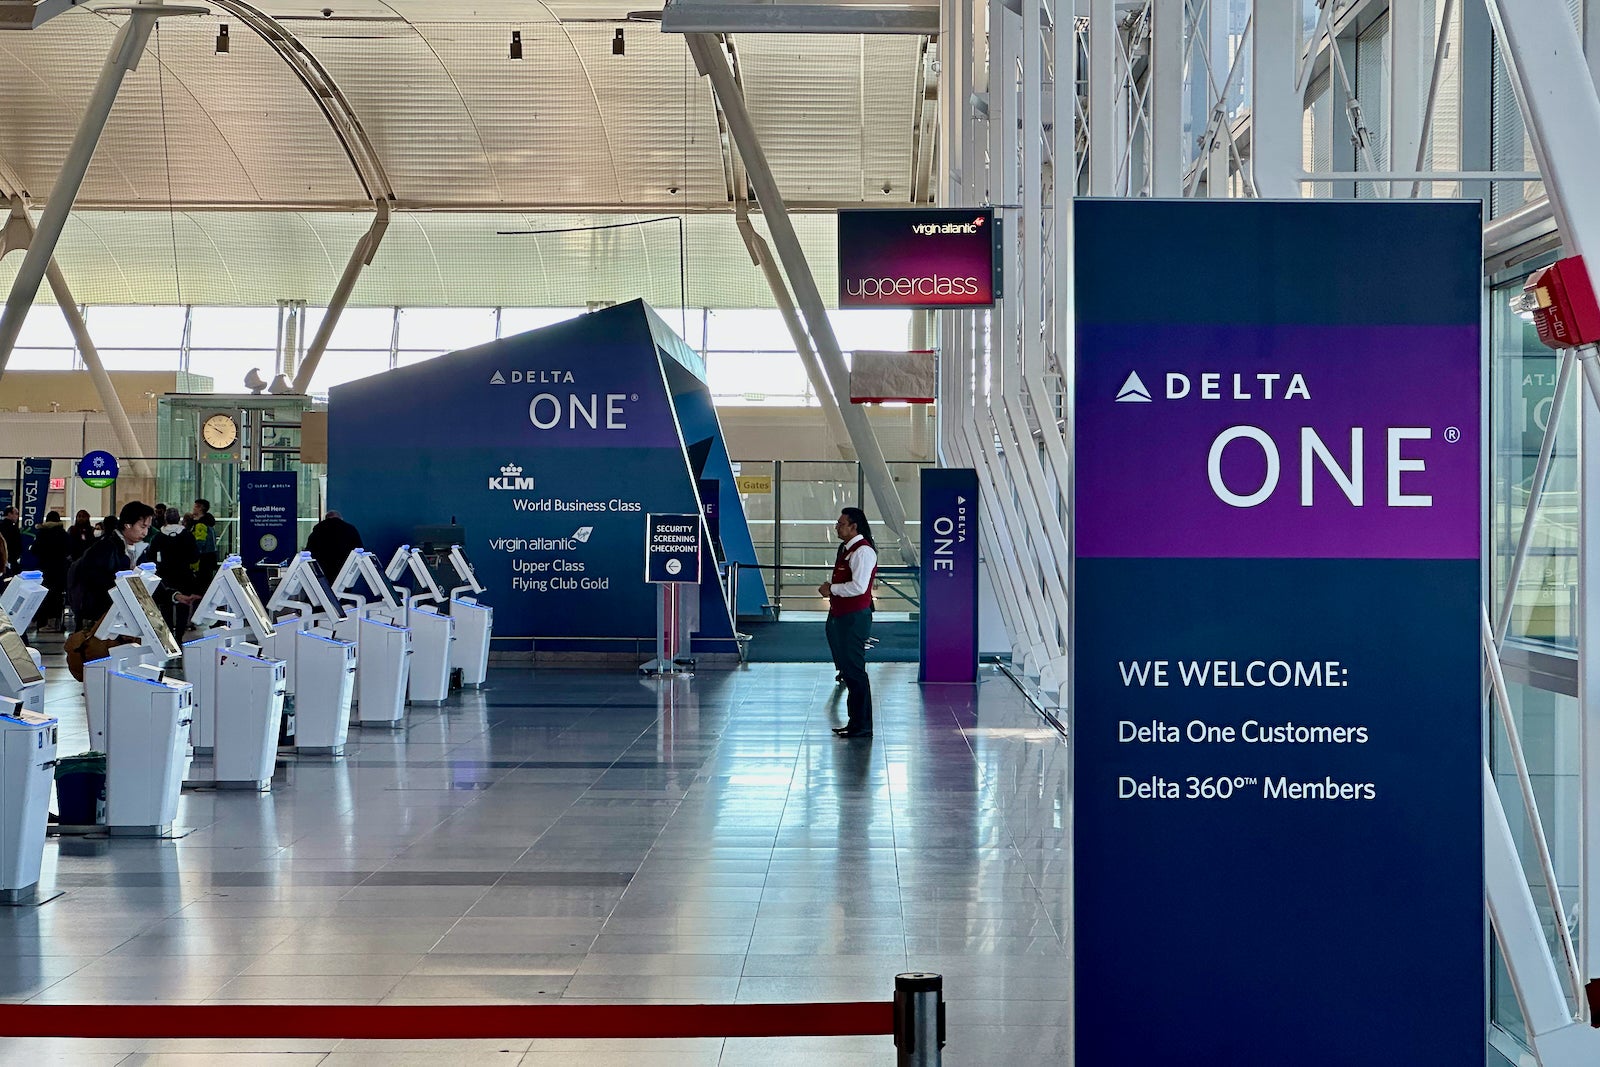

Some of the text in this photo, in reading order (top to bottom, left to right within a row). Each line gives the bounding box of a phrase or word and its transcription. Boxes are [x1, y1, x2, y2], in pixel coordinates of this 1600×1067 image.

[846, 274, 978, 300] upperclass
[1549, 306, 1566, 338] FIRE
[511, 371, 575, 383] DELTA
[1166, 373, 1311, 400] DELTA
[488, 477, 534, 490] KLM
[743, 481, 769, 489] Gates
[25, 481, 38, 504] TSA
[512, 498, 642, 512] World Business Class
[656, 524, 693, 533] SECURITY
[958, 507, 966, 543] DELTA
[488, 537, 577, 553] virgin atlantic
[653, 534, 696, 543] SCREENING
[650, 544, 698, 553] CHECKPOINT
[512, 559, 586, 574] Upper Class
[512, 577, 609, 593] Flying Club Gold
[1118, 660, 1348, 687] WE WELCOME:
[1119, 719, 1369, 744] Delta One Customers
[1119, 775, 1180, 799] Delta
[1263, 775, 1376, 800] Members
